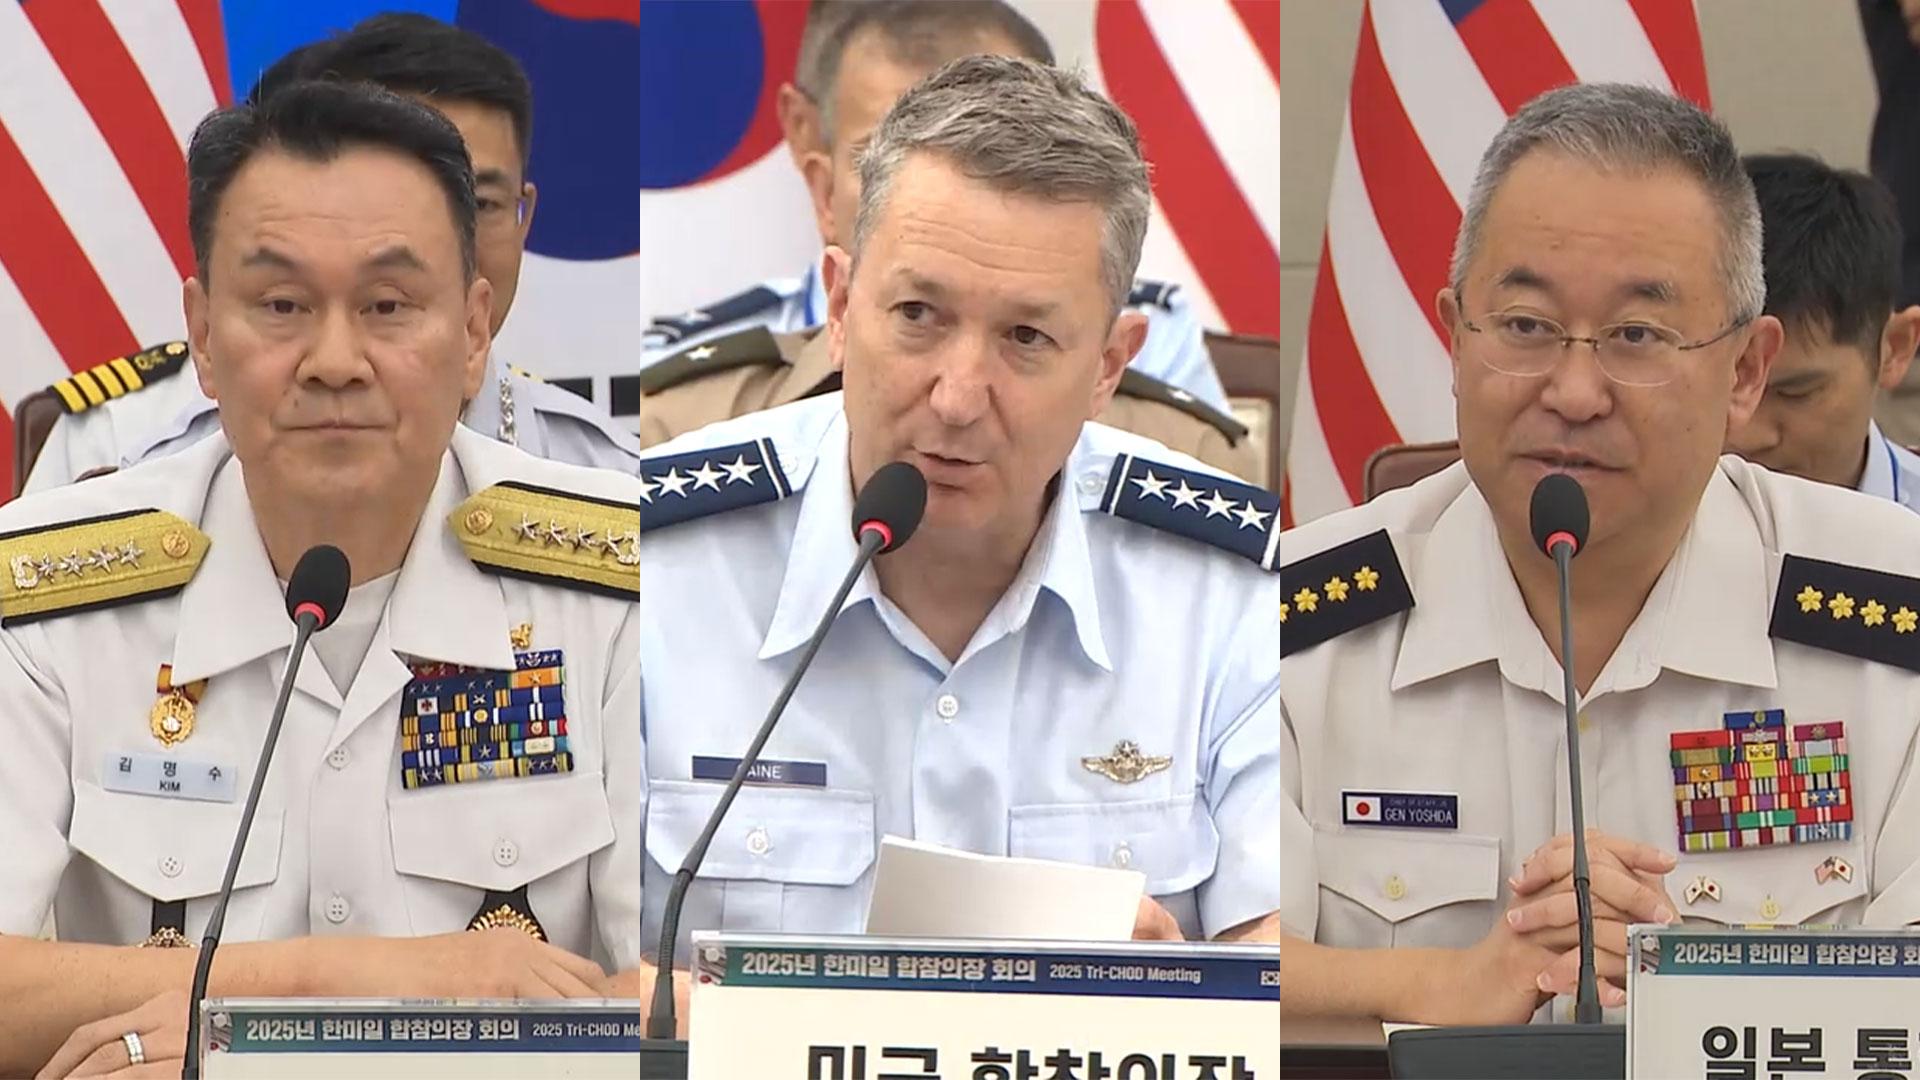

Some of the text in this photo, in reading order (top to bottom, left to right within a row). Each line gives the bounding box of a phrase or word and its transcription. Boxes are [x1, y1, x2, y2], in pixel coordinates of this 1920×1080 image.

[738, 765, 782, 779] AINE
[159, 781, 181, 792] KIM
[1385, 807, 1454, 823] GEN YOSHIDA
[1674, 943, 1742, 964] 2025년
[1749, 943, 1808, 965] 한미일
[1816, 943, 1898, 966] 합참의장
[742, 953, 1036, 982] 2025년 한미일 합참의장 회의
[1050, 964, 1201, 984] 2025 Tri-CHOD Meeting
[247, 1019, 519, 1041] 2025년 한미일 합참의장 회의
[533, 1023, 562, 1037] 2025
[567, 1023, 620, 1037] Tri-CHOD
